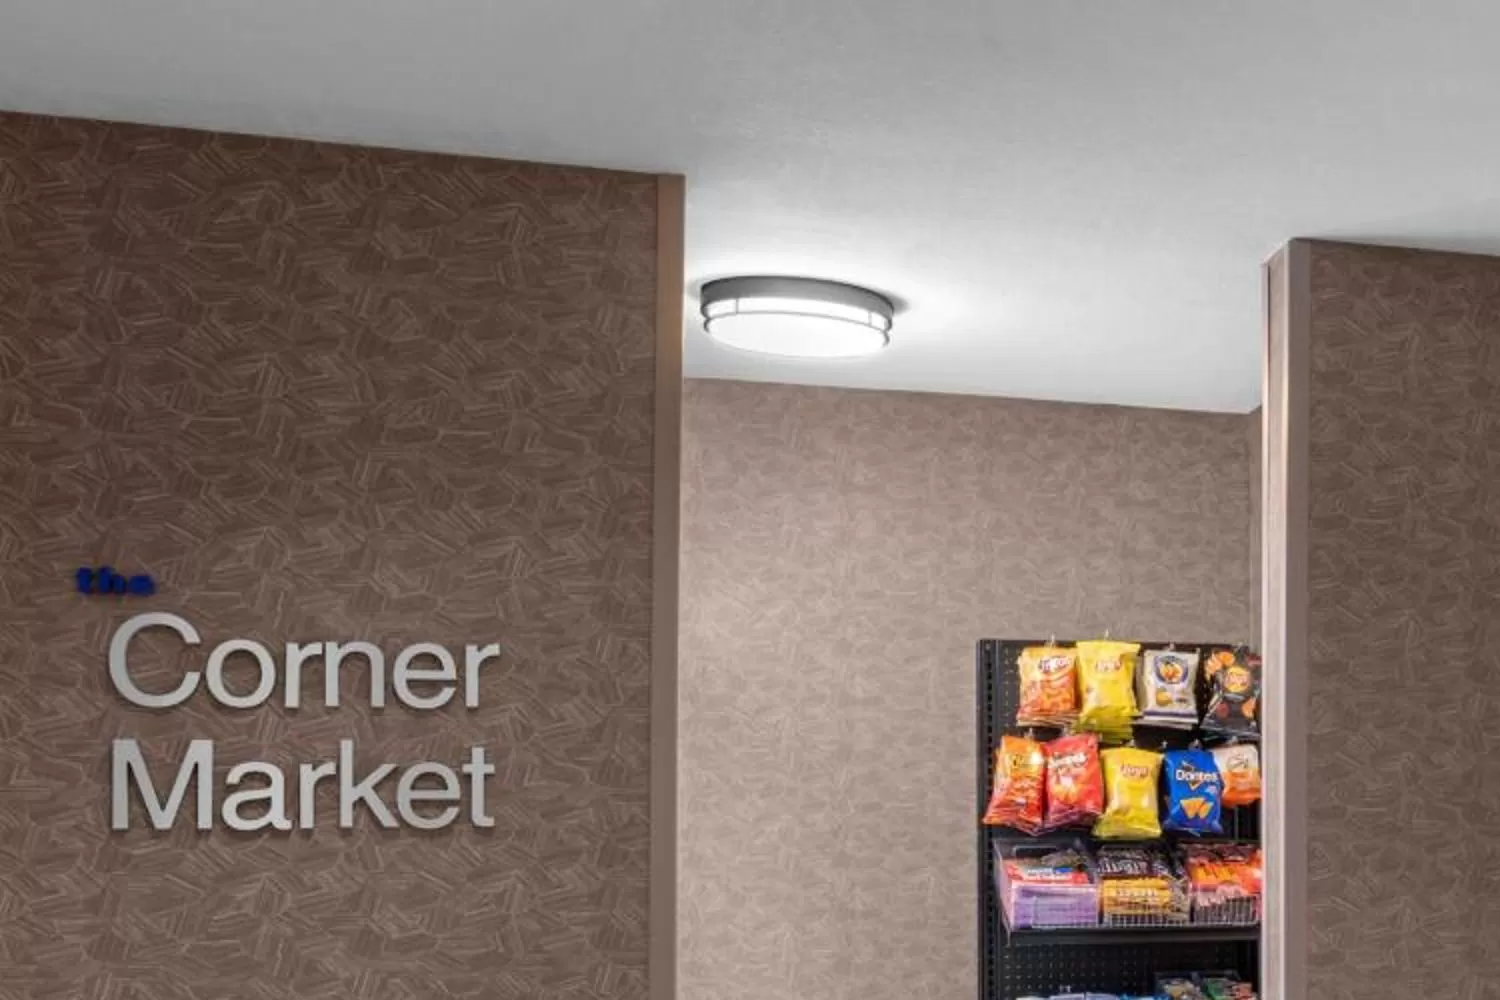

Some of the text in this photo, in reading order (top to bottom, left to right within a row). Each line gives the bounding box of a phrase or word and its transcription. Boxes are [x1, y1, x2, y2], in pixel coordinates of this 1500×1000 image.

[75, 566, 156, 597] the
[108, 611, 501, 709] Corner
[112, 738, 496, 832] Market
